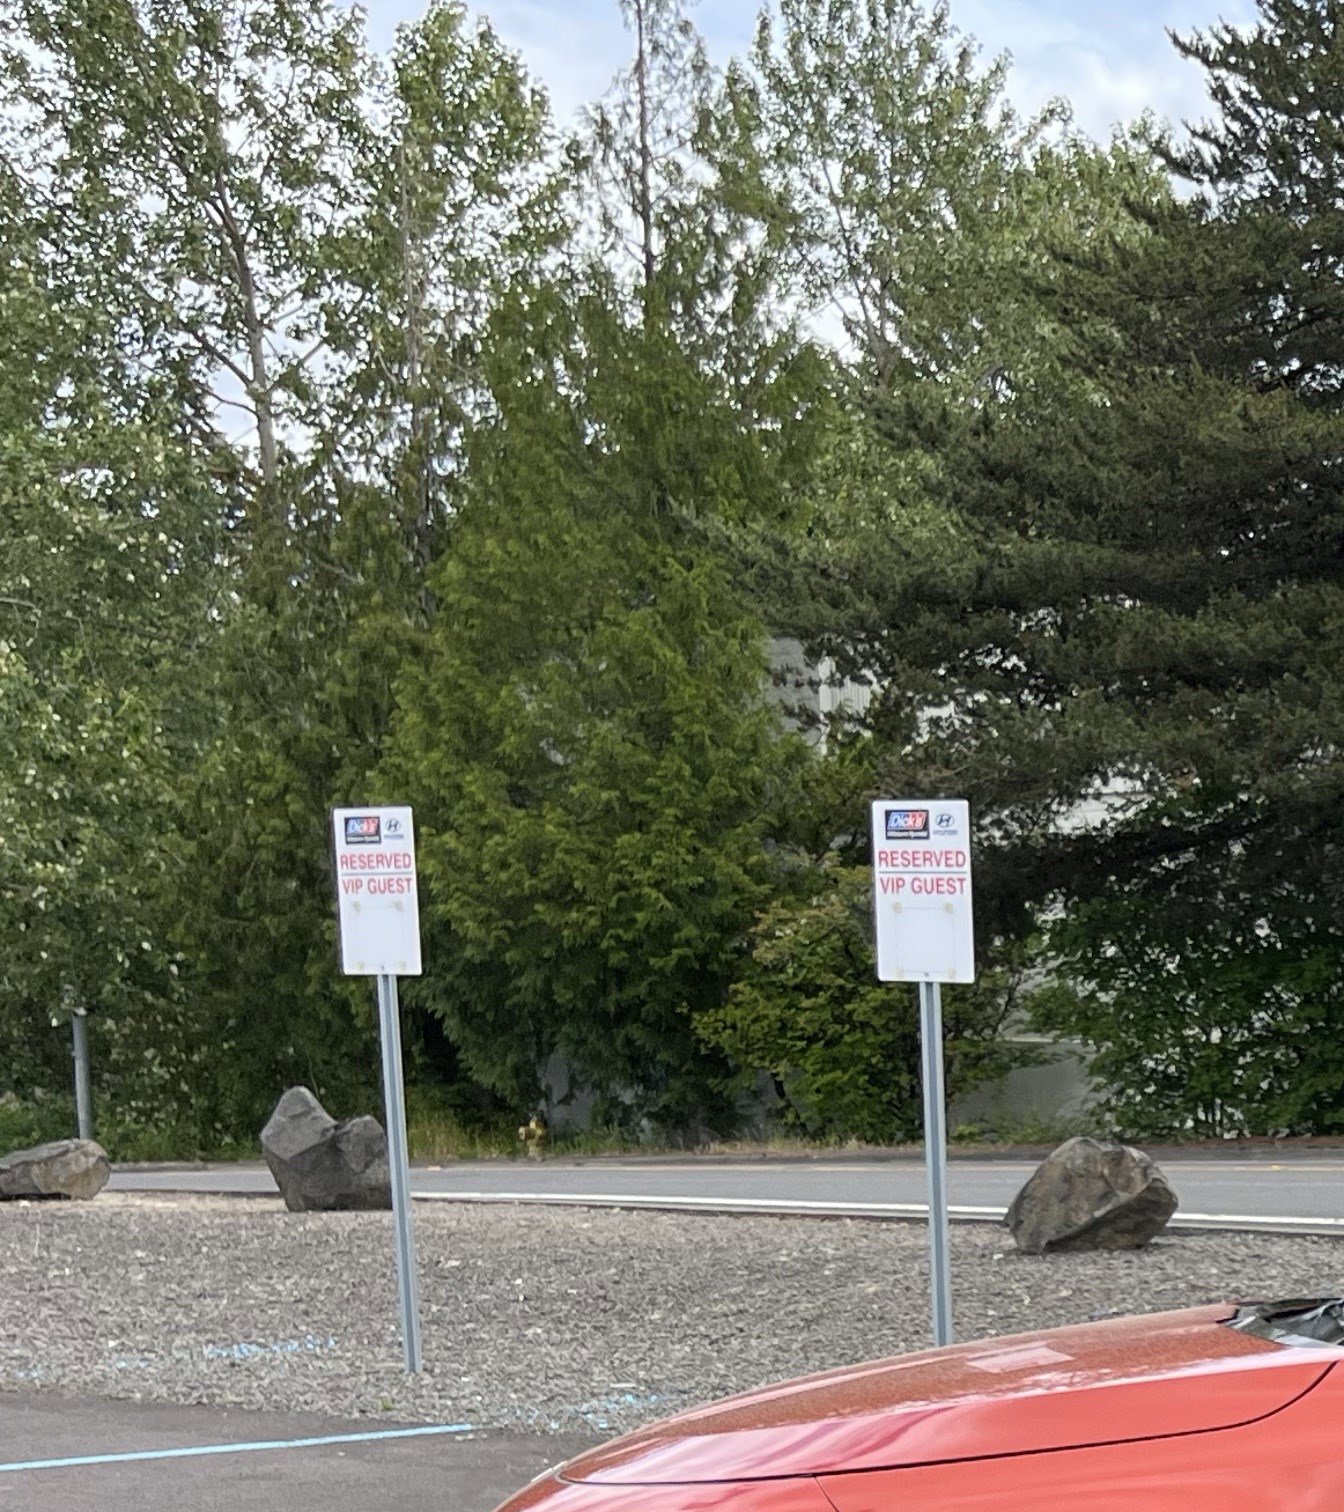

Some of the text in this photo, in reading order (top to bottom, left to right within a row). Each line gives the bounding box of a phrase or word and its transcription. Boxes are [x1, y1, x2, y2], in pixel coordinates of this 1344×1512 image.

[340, 852, 412, 871] RESERVED
[878, 850, 967, 869] RESERVED
[342, 877, 413, 895] VIP GUEST
[879, 876, 967, 895] VIP GUEST
